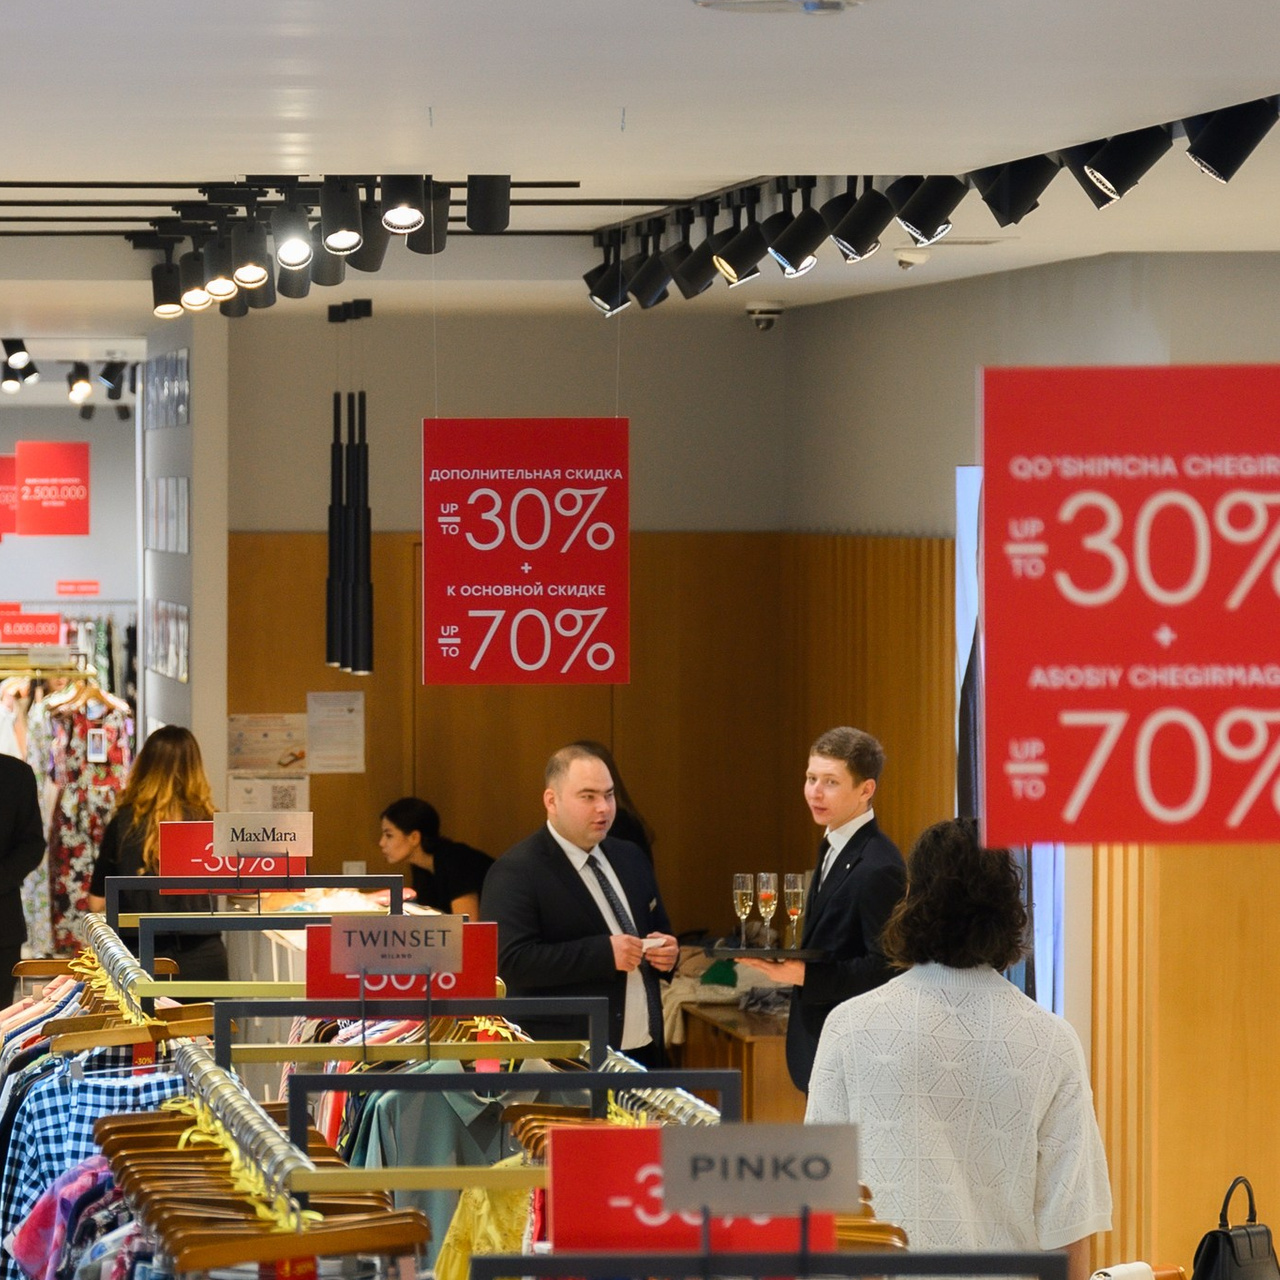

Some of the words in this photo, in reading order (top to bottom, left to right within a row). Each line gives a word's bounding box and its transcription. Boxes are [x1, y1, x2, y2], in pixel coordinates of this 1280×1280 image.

[430, 469, 561, 481] ДОПОЛНИТЕЛЬНАЯ
[565, 469, 623, 481] СКИДКА
[22, 486, 87, 500] 2.500.000
[441, 503, 459, 514] UP
[441, 524, 460, 535] TO
[465, 486, 615, 553] 30%
[1009, 519, 1046, 539] UP
[1054, 490, 1280, 609] 30%
[1011, 557, 1046, 578] TO
[447, 585, 456, 596] К
[460, 582, 544, 596] ОСНОВНОЙ
[547, 585, 606, 597] СКИДКЕ
[441, 625, 459, 636] UP
[468, 607, 615, 673] 70%
[441, 646, 460, 657] TO
[1029, 666, 1122, 688] ASOSIY
[1009, 739, 1046, 759] UP
[1058, 706, 1280, 827] 70%
[1011, 778, 1046, 800] TO
[230, 827, 297, 842] MaxMara
[343, 930, 452, 947] TWINSET
[691, 1155, 831, 1181] PINKO
